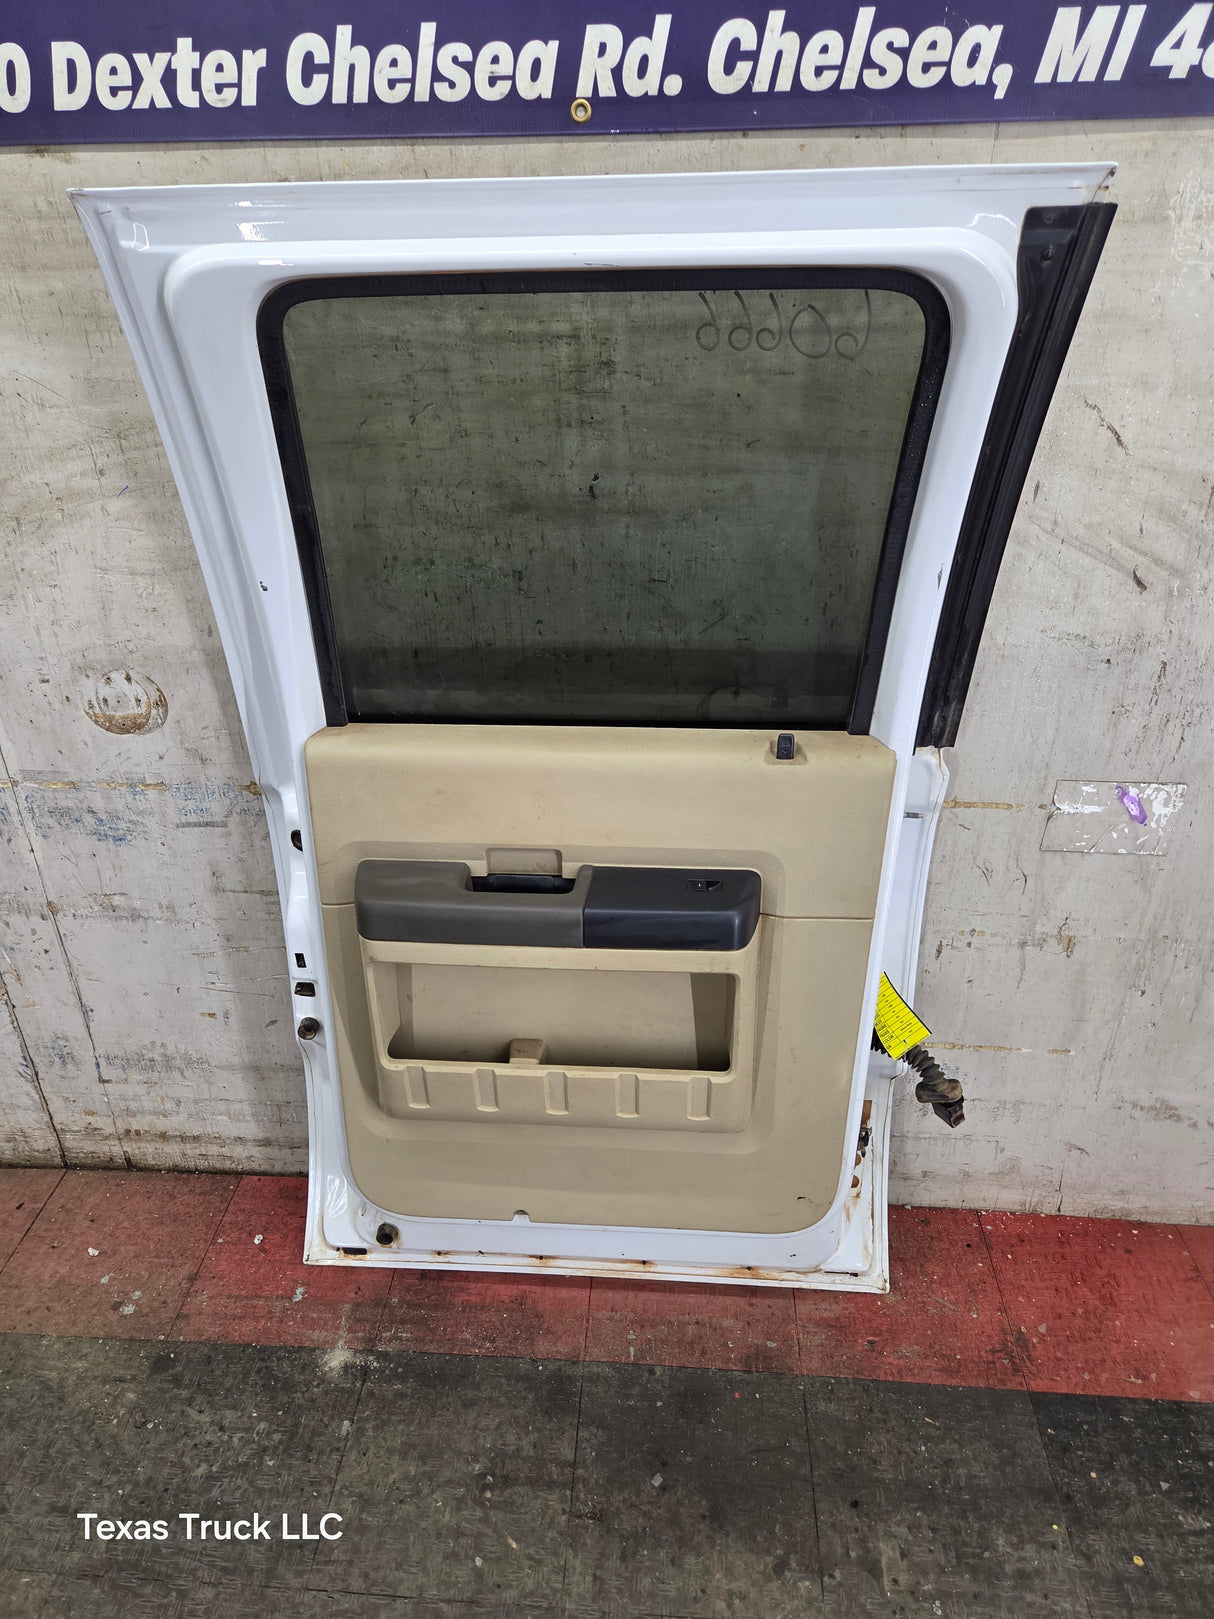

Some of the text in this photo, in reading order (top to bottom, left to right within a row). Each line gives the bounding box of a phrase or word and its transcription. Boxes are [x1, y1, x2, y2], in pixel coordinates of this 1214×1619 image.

[51, 38, 266, 111] Dexter
[286, 22, 559, 105] Chelsea
[576, 14, 682, 97] Rd.
[708, 7, 1013, 99] Chelsea,
[1034, 5, 1147, 83] MI
[1150, 3, 1214, 79] 4
